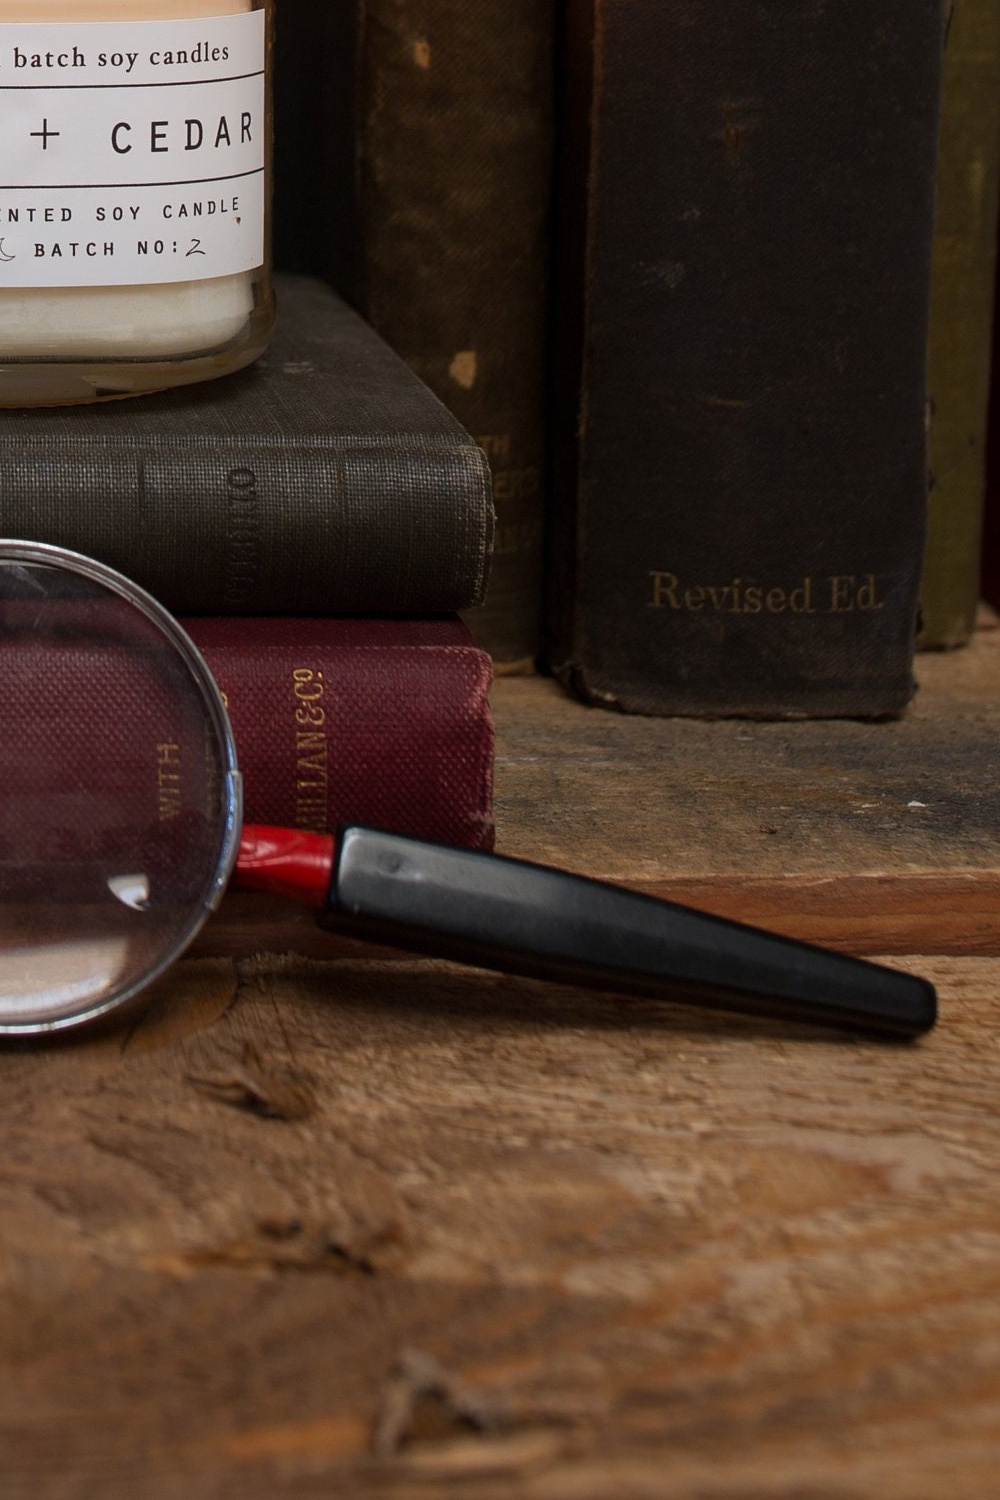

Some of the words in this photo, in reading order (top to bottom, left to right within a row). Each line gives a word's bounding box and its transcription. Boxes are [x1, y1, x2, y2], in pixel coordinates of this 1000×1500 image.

[13, 46, 87, 68] batch
[98, 52, 139, 73] soy
[149, 41, 230, 66] candles
[30, 118, 60, 150] +
[111, 111, 252, 155] CEDAR
[96, 206, 140, 222] SOY
[163, 196, 239, 219] CANDLE
[34, 242, 114, 257] BATCH
[648, 570, 816, 613] Revised
[830, 572, 886, 612] Ed.
[157, 741, 182, 822] WITH
